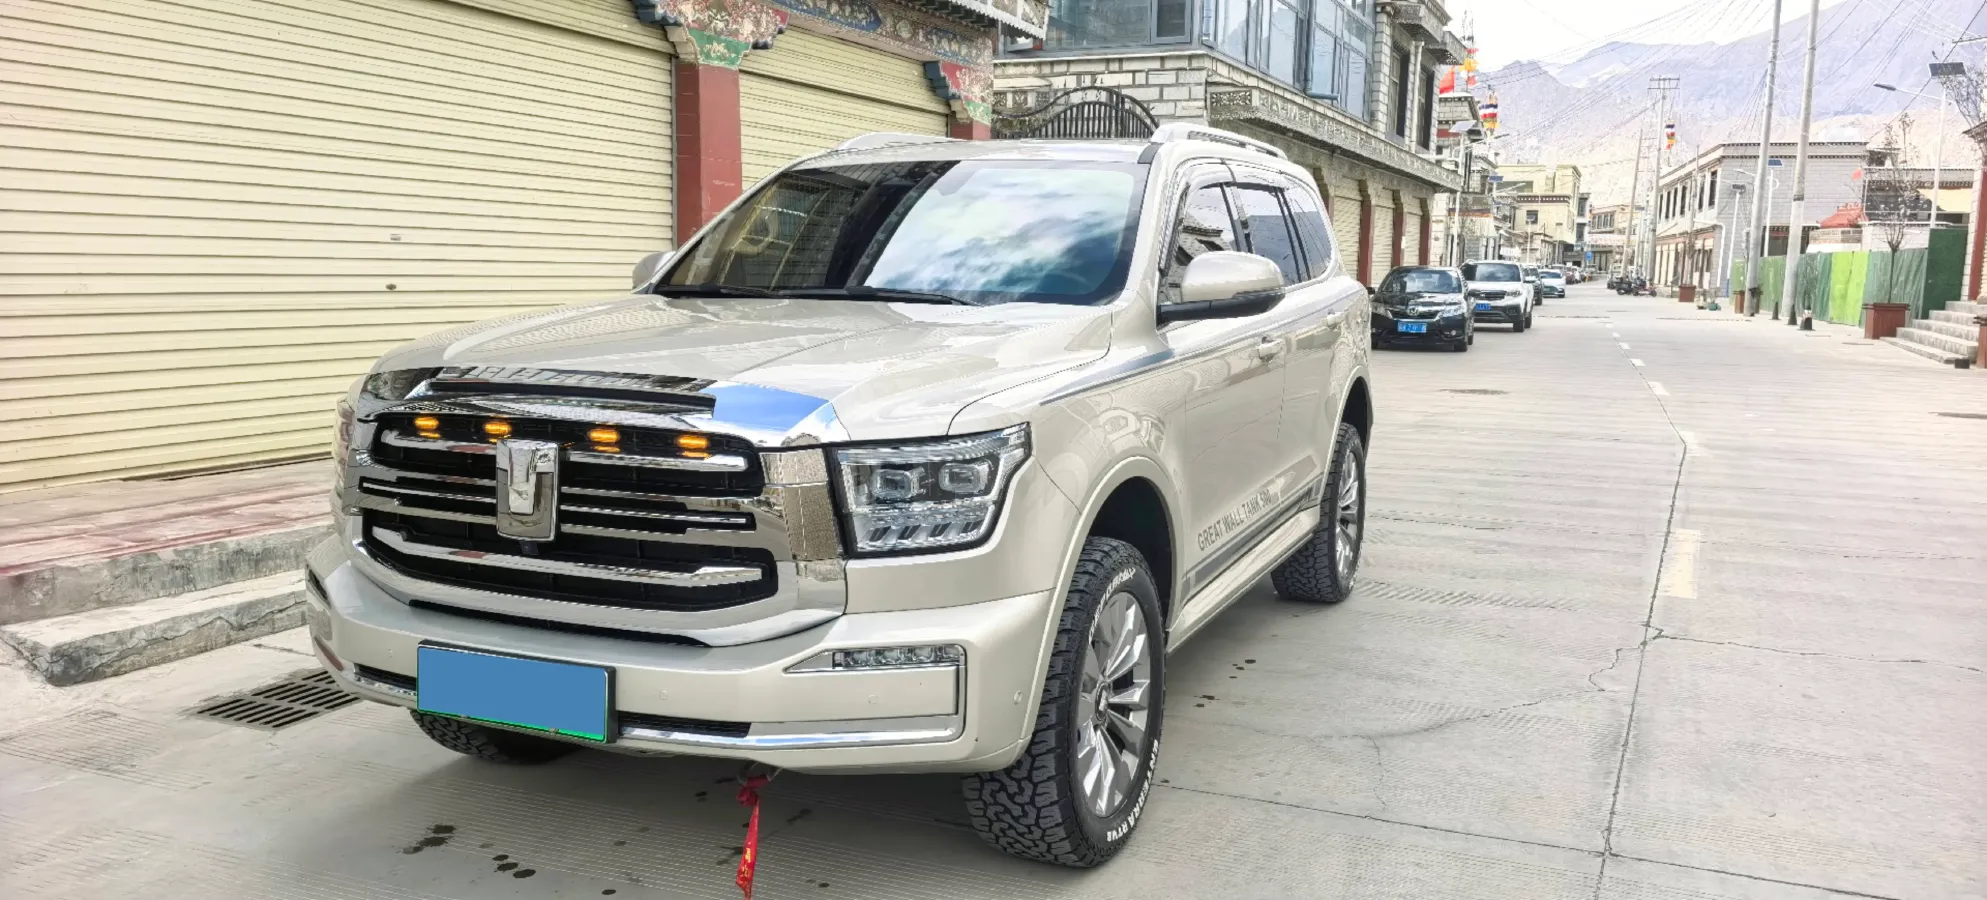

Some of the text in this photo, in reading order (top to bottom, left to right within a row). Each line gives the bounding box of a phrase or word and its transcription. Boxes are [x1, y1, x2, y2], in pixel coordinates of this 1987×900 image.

[1197, 519, 1223, 552] GREAT
[1222, 507, 1245, 535] WALL
[1241, 494, 1262, 520] TANK
